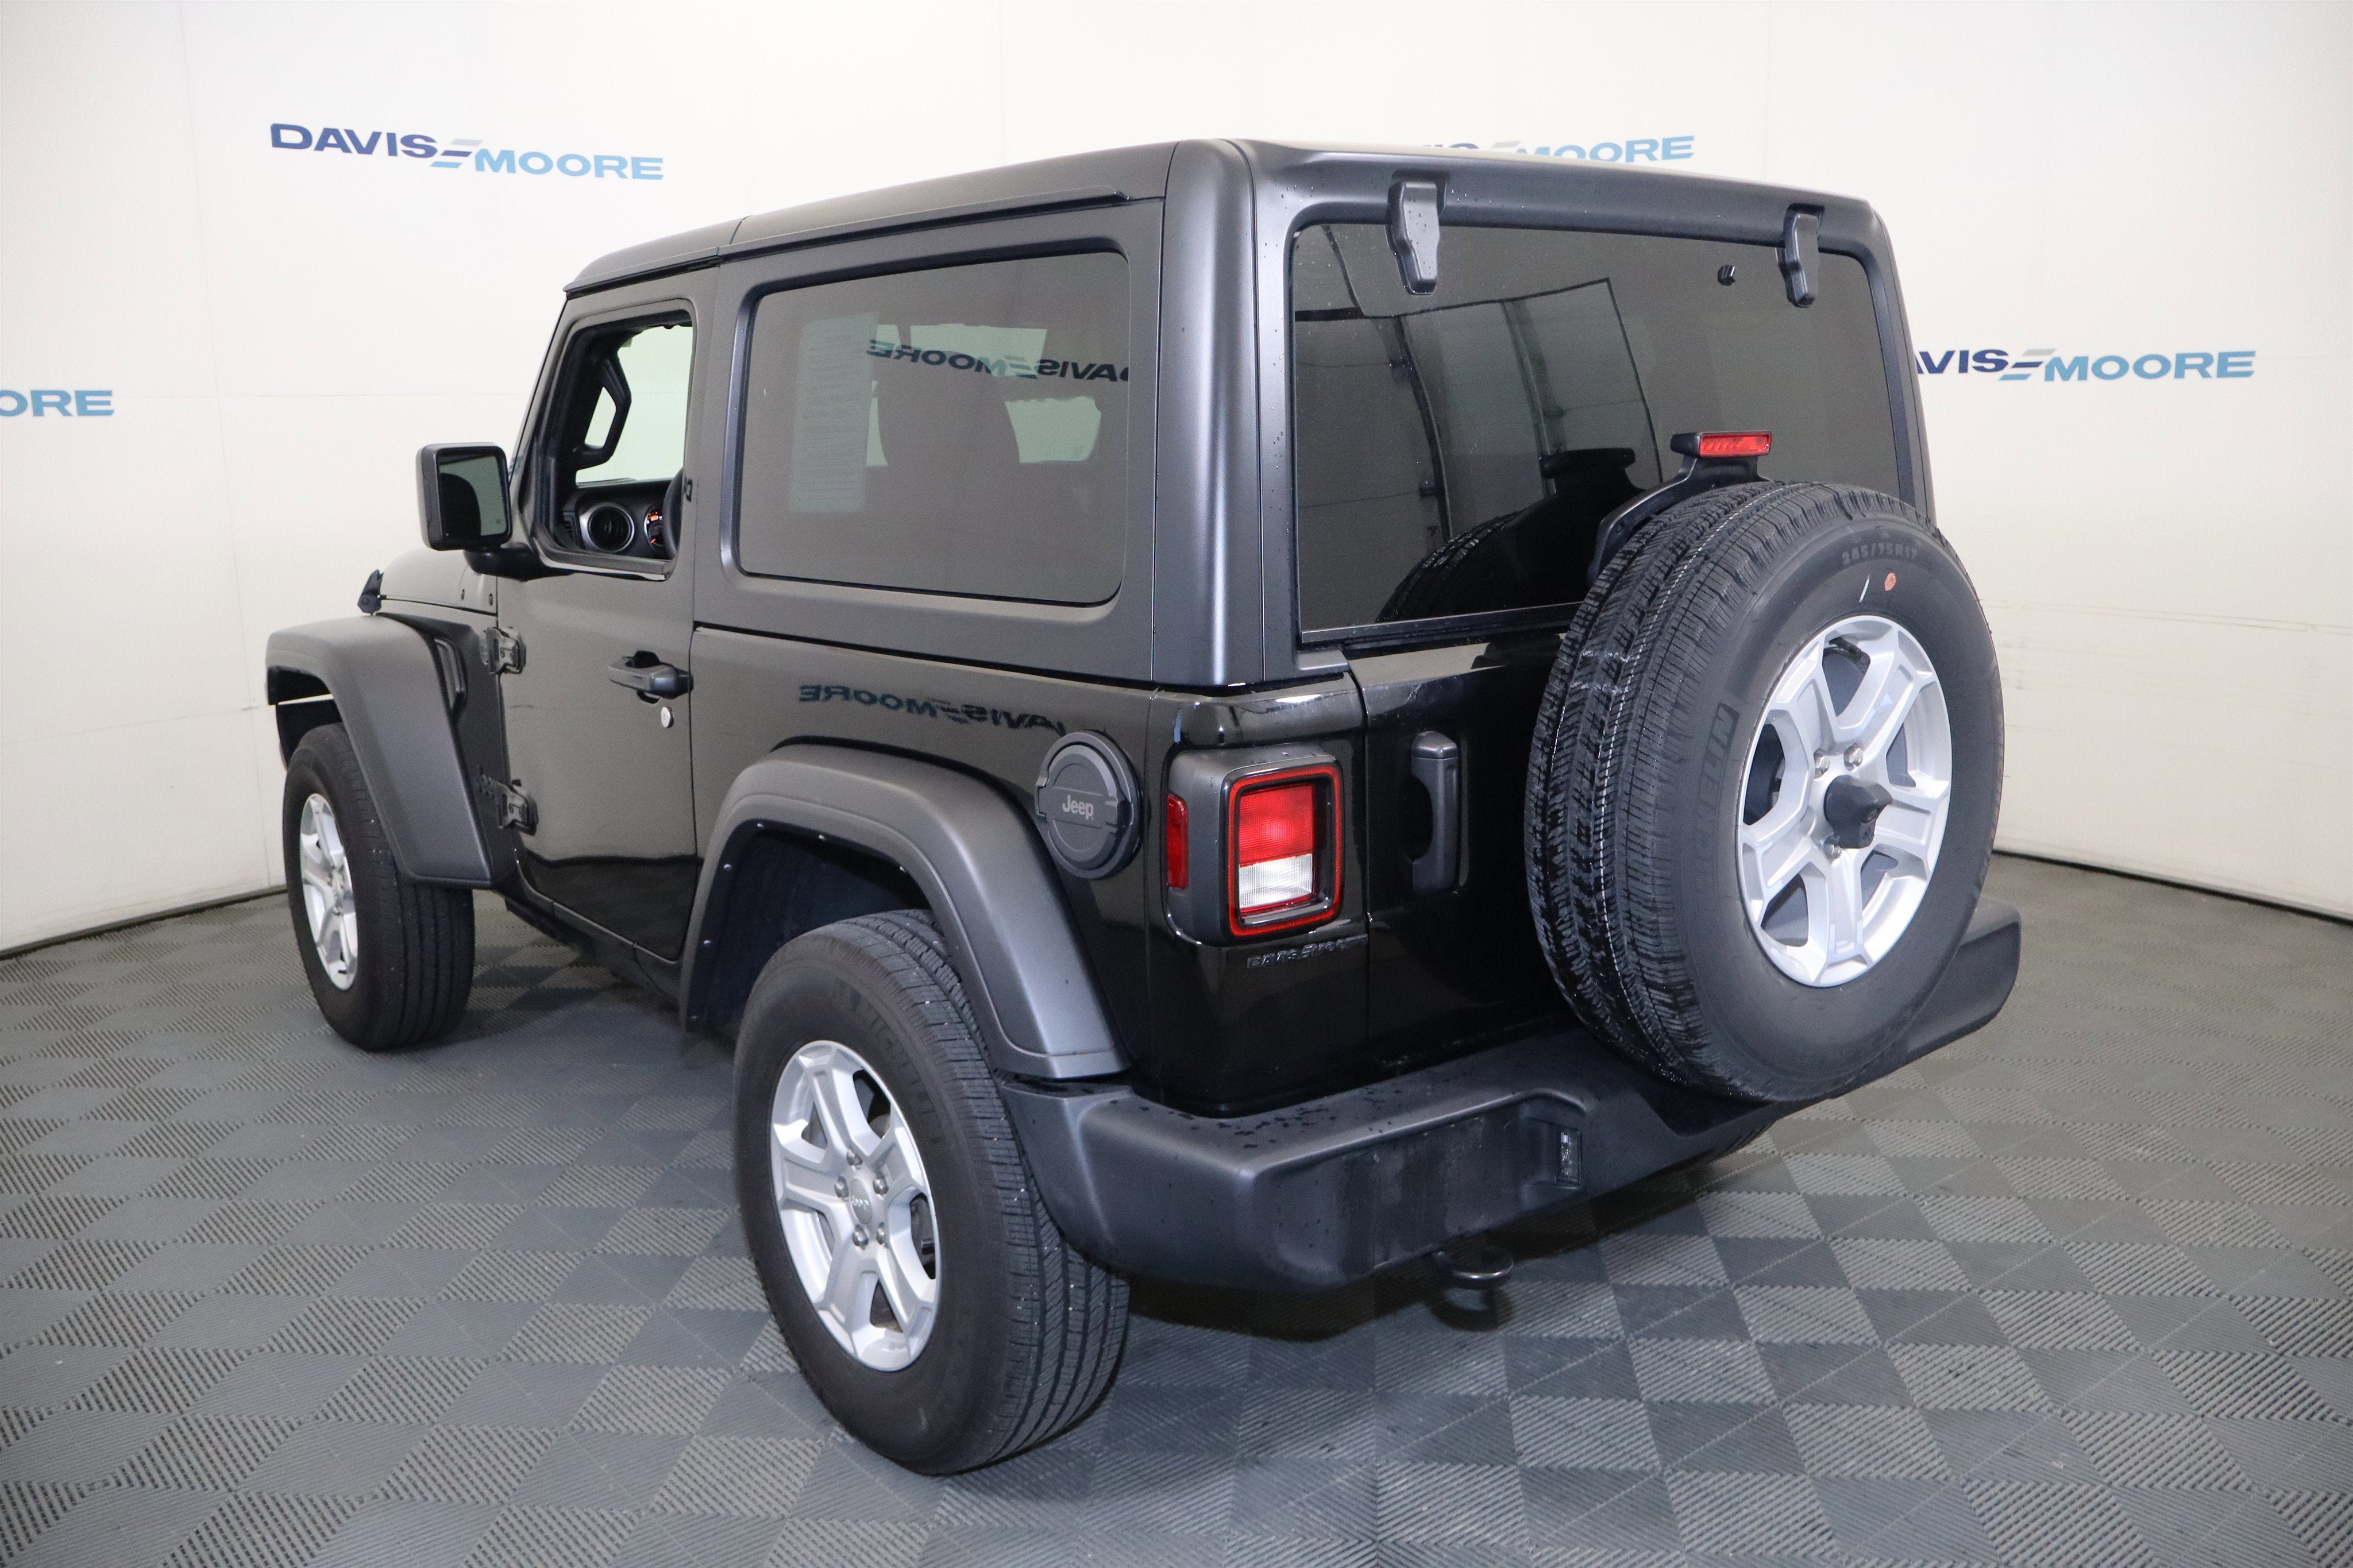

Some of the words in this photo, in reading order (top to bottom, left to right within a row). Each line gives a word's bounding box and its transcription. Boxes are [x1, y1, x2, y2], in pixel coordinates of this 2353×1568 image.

[271, 123, 437, 158] DAVIS
[475, 148, 664, 179] MOORE
[2044, 351, 2256, 381] MOORE
[1062, 794, 1094, 820] Jeep
